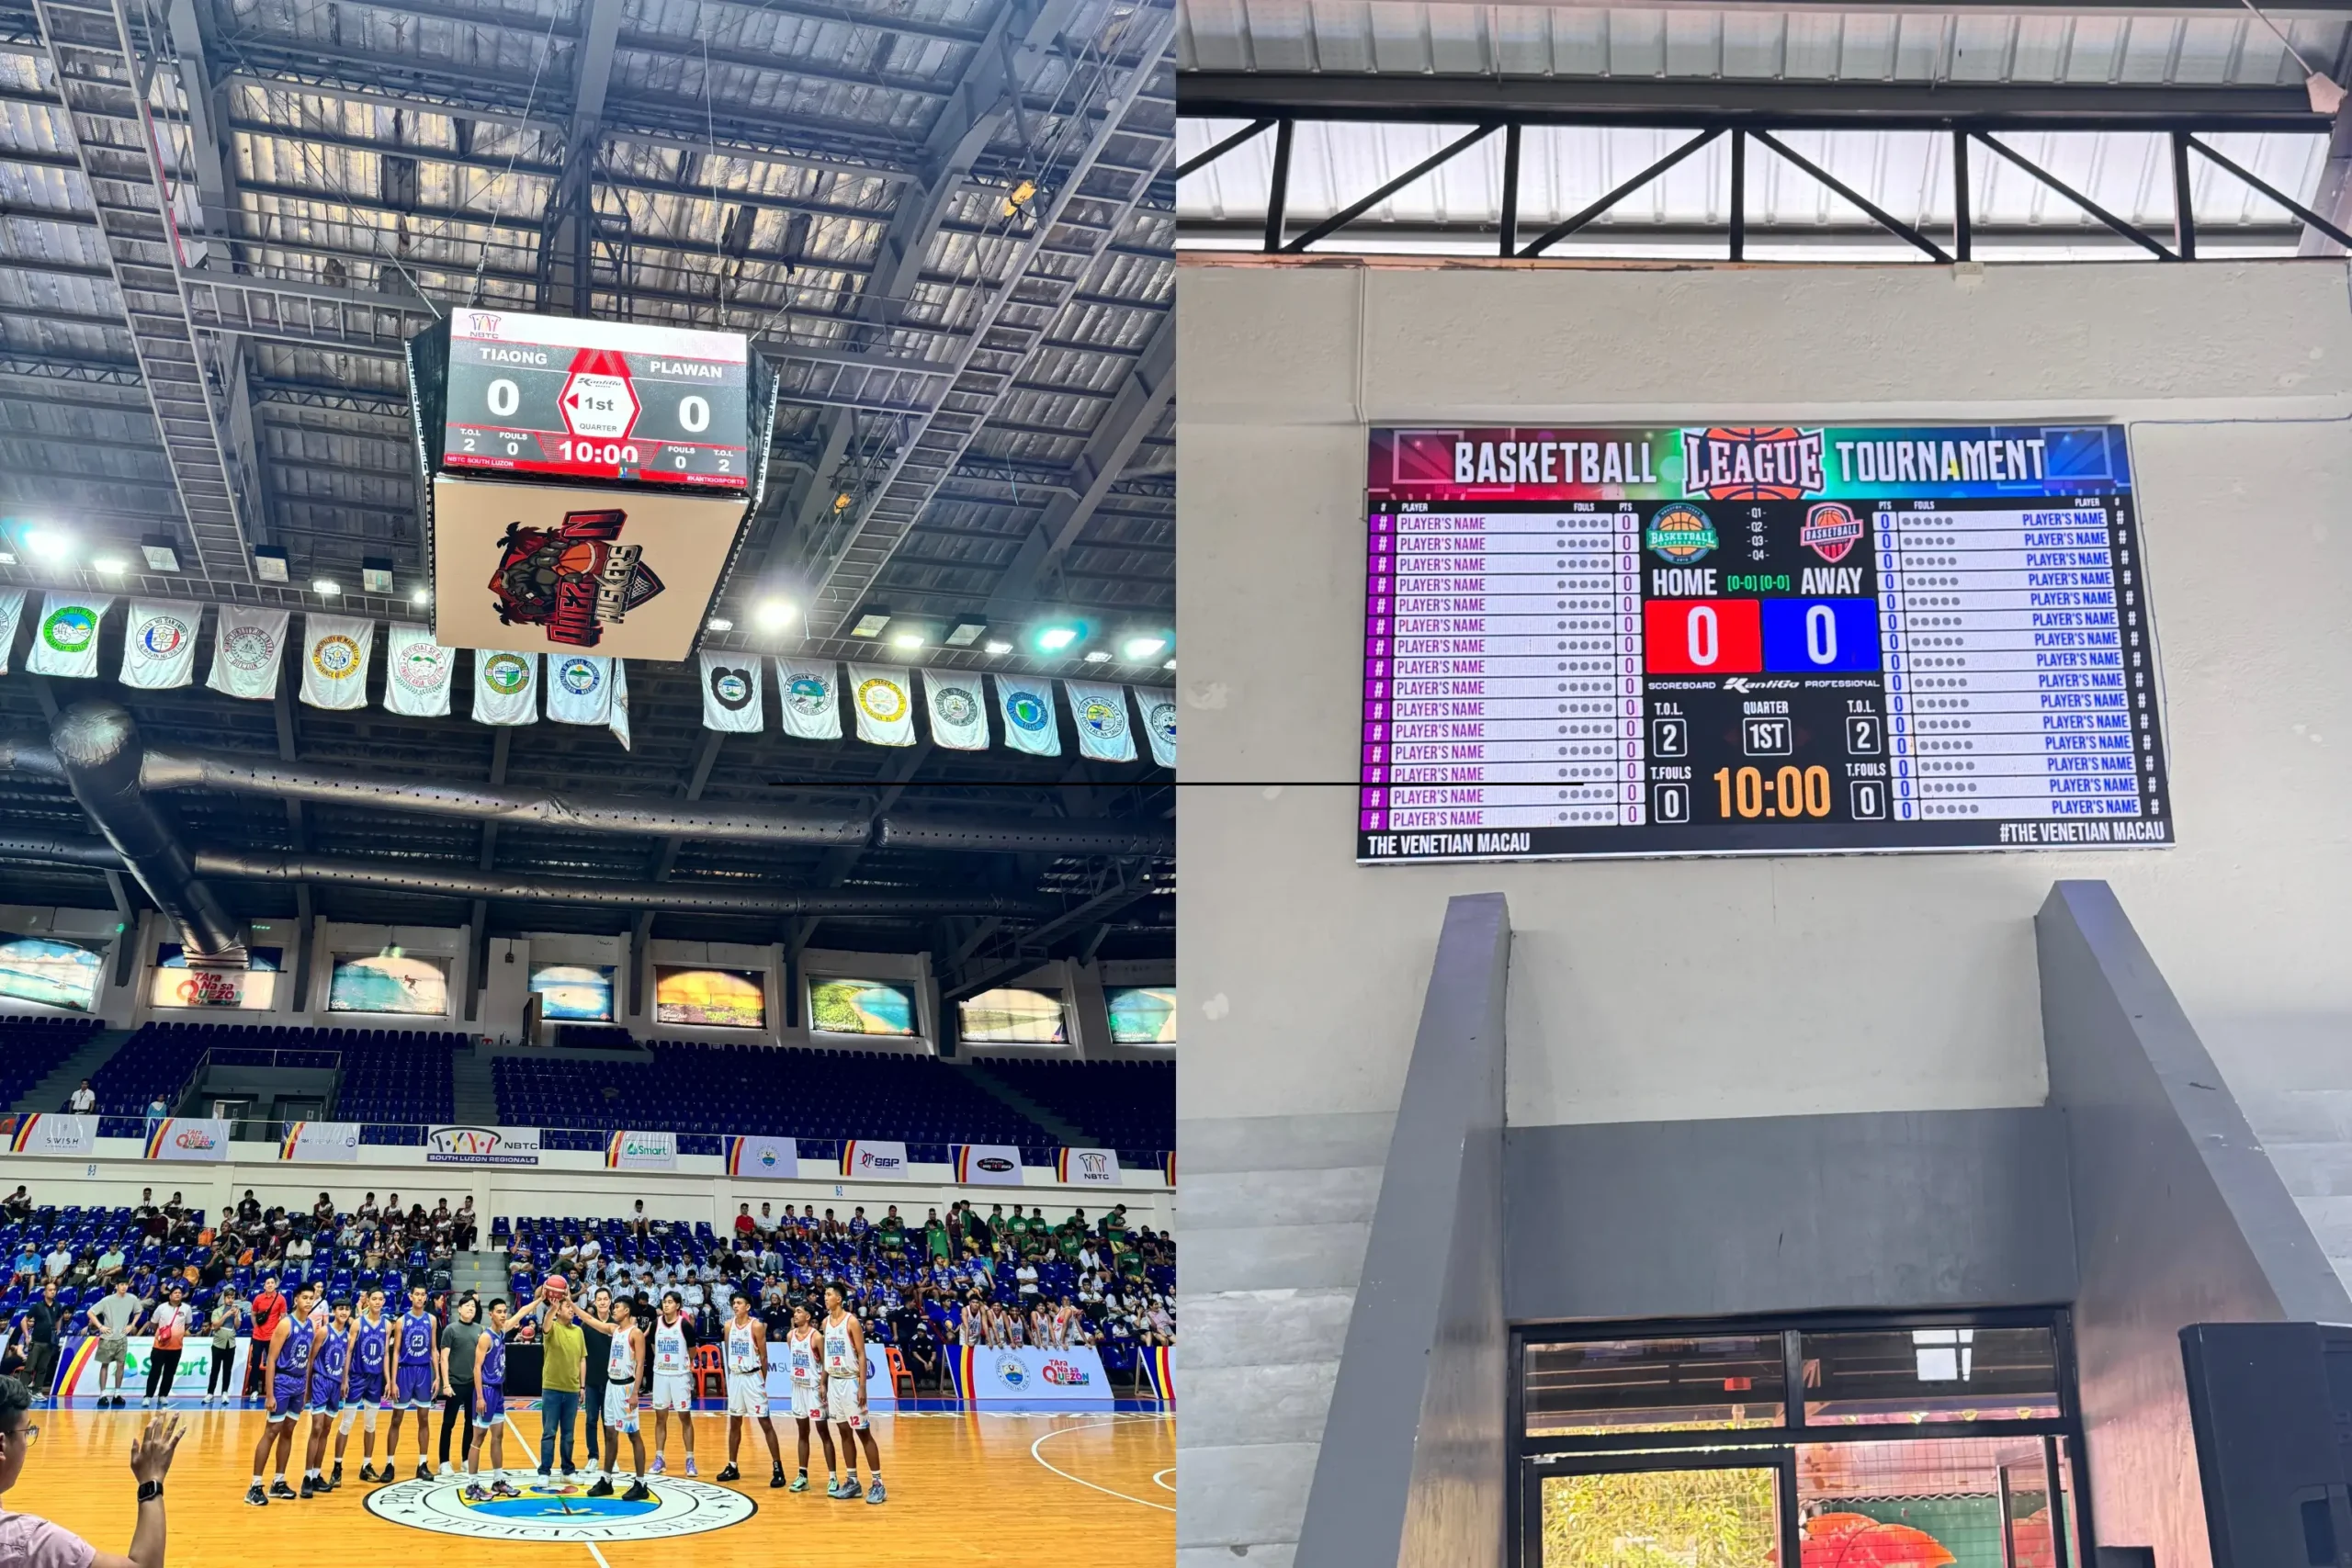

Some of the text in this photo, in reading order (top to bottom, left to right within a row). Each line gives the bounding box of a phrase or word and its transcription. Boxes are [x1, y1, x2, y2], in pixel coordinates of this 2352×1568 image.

[469, 331, 499, 339] NBTC
[480, 347, 548, 365] TIAONG
[650, 360, 723, 378] PLAWAN
[487, 378, 520, 416] 0
[584, 397, 614, 412] 1st
[679, 395, 710, 433] 0
[459, 428, 481, 436] T.O.L
[579, 423, 617, 433] QUARTER
[499, 432, 527, 440] FOULS
[463, 438, 475, 452] 2
[506, 442, 519, 456] 0
[559, 440, 639, 465] 10:00
[667, 446, 695, 454] FOULS
[675, 456, 686, 468] 0
[718, 459, 729, 472] 2
[1454, 435, 2045, 491] BASKETBALL LEAGUE TOURNAMENT
[1401, 502, 1633, 512] PLAYER FOULS PTS
[1878, 498, 2100, 510] PTS FOULS PLAYER
[1400, 516, 1486, 530] PLAYER'S NAME
[2022, 511, 2105, 526] PLAYER'S NAME
[1651, 532, 1714, 544] BASKETBALL
[1805, 524, 1857, 541] BASKETBALL
[2024, 531, 2107, 547] PLAYER'S NAME
[1400, 536, 1486, 551] PLAYER'S NAME
[1399, 558, 1486, 571] PLAYER'S NAME
[2026, 551, 2109, 567] PLAYER'S NAME
[594, 545, 643, 624] HUSKERS
[1399, 578, 1486, 592] PLAYER'S NAME
[1652, 569, 1718, 596] HOME
[1801, 567, 1863, 594] AWAY
[2028, 571, 2110, 586] PLAYER'S NAME
[1398, 598, 1486, 612] PLAYER'S NAME
[2030, 591, 2114, 606] PLAYER'S NAME
[1398, 618, 1486, 633] PLAYER'S NAME
[2032, 611, 2116, 626] PLAYER'S NAME
[1687, 605, 1718, 666] 0
[1805, 604, 1838, 665] 0
[2034, 631, 2118, 647] PLAYER'S NAME
[1397, 638, 1485, 653] PLAYER'S NAME
[2036, 651, 2120, 667] PLAYER'S NAME
[1396, 660, 1485, 674] PLAYER'S NAME
[1396, 680, 1485, 695] PLAYER'S NAME
[1647, 682, 1716, 690] SCOREBOARD
[1804, 680, 1880, 688] PROFESSIONAL
[2038, 672, 2123, 688] PLAYER'S NAME
[1847, 699, 1876, 714] T.O.L.
[2040, 693, 2125, 708] PLAYER'S NAME
[1396, 702, 1485, 716] PLAYER'S NAME
[1654, 702, 1684, 716] T.O.L.
[1743, 701, 1789, 716] QUARTER
[1662, 724, 1678, 751] 2
[1749, 723, 1784, 749] 1ST
[1856, 721, 1871, 749] 2
[1650, 766, 1691, 781] T.FOULS
[1846, 763, 1886, 778] T.FOULS
[1713, 764, 1831, 819] 10:00
[1664, 788, 1679, 818] 0
[1860, 786, 1874, 816] 0
[2000, 821, 2165, 842] #THE VENETIAN MACAU
[1368, 833, 1531, 854] THE VENETIAN MACAU
[46, 1136, 79, 1145] SWISH
[504, 1142, 538, 1150] NBTC
[638, 1145, 667, 1156] Smart
[874, 1157, 899, 1167] SBP
[1083, 1172, 1110, 1180] NBTC
[412, 1335, 424, 1348] 23
[296, 1344, 307, 1358] 32
[140, 1356, 209, 1376] Sart
[334, 1352, 340, 1366] 7
[1043, 1365, 1090, 1383] QUEZON
[850, 1416, 860, 1426] 12
[422, 1513, 729, 1539] OFFICIAL SEAL
